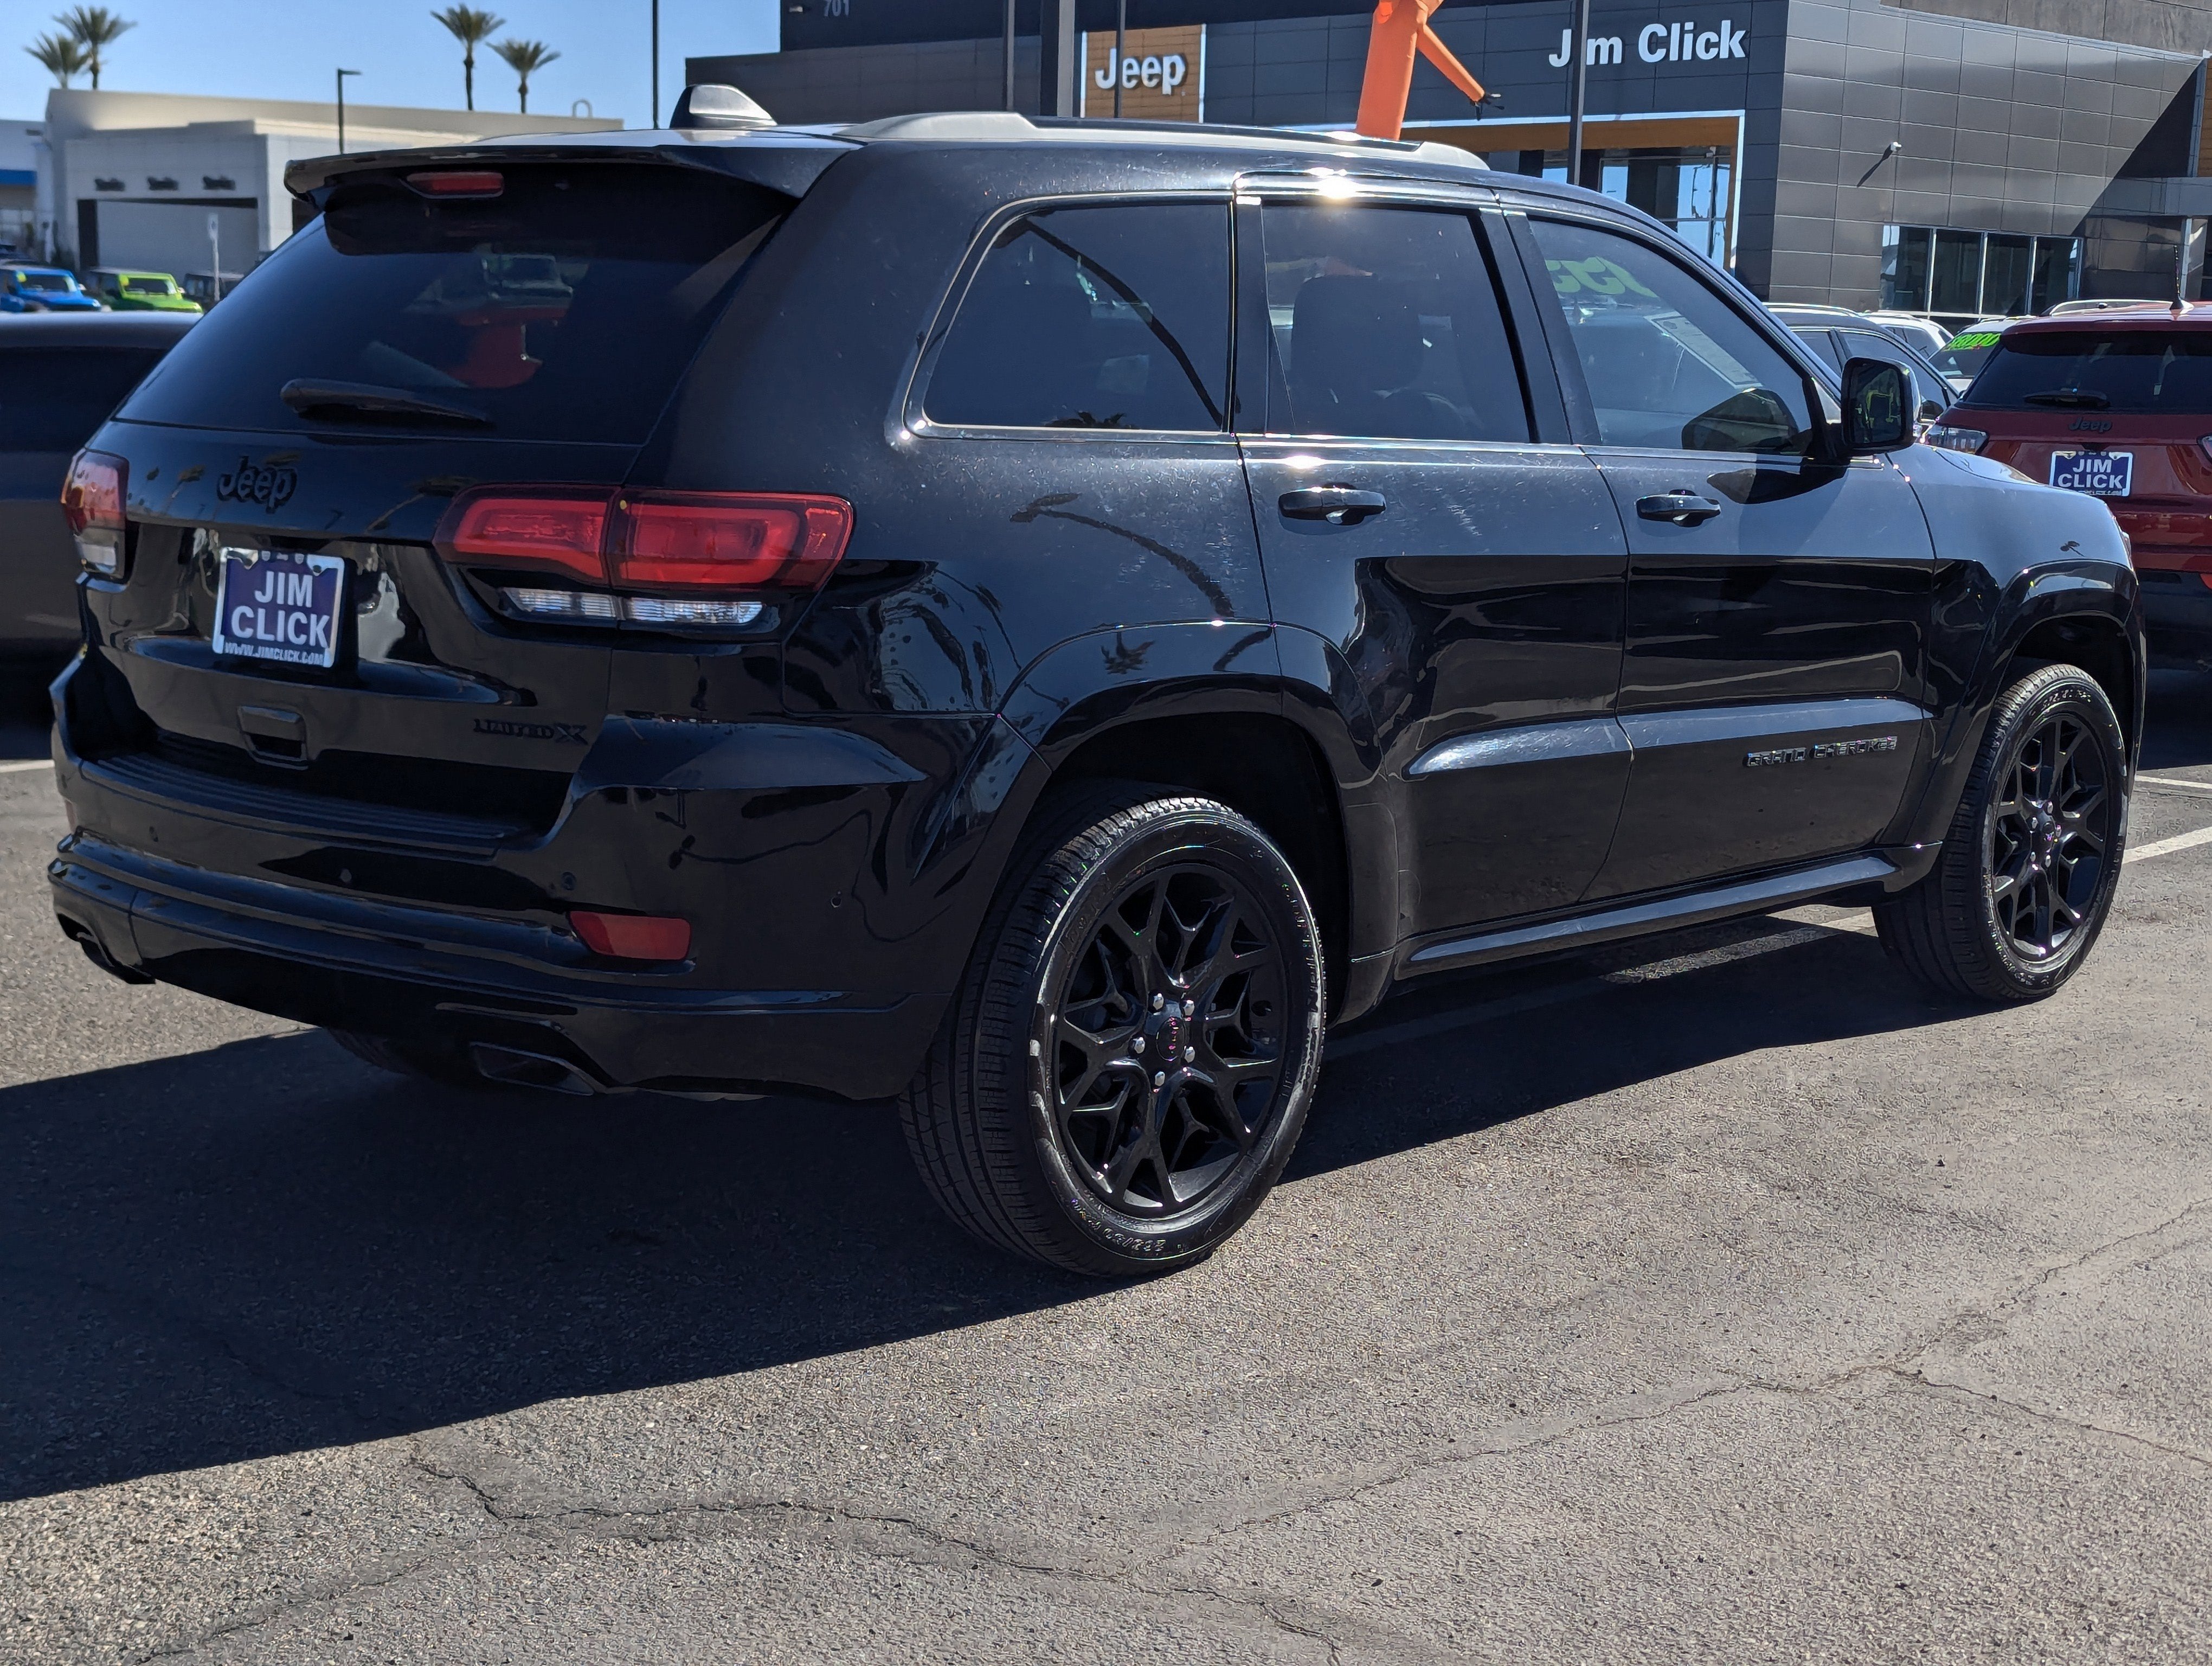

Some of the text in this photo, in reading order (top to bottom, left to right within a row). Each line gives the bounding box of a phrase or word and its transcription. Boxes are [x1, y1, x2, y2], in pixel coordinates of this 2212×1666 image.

[1549, 20, 1746, 67] Jm Click
[1095, 48, 1186, 95] Jeep
[2069, 416, 2112, 433] Jeep
[2057, 474, 2124, 489] CLICK
[2073, 459, 2112, 472] JIM
[218, 456, 296, 512] Jeep
[254, 571, 313, 607] JIM
[231, 606, 330, 648] CLICK
[1746, 736, 1898, 767] GRAND CHEROKEE
